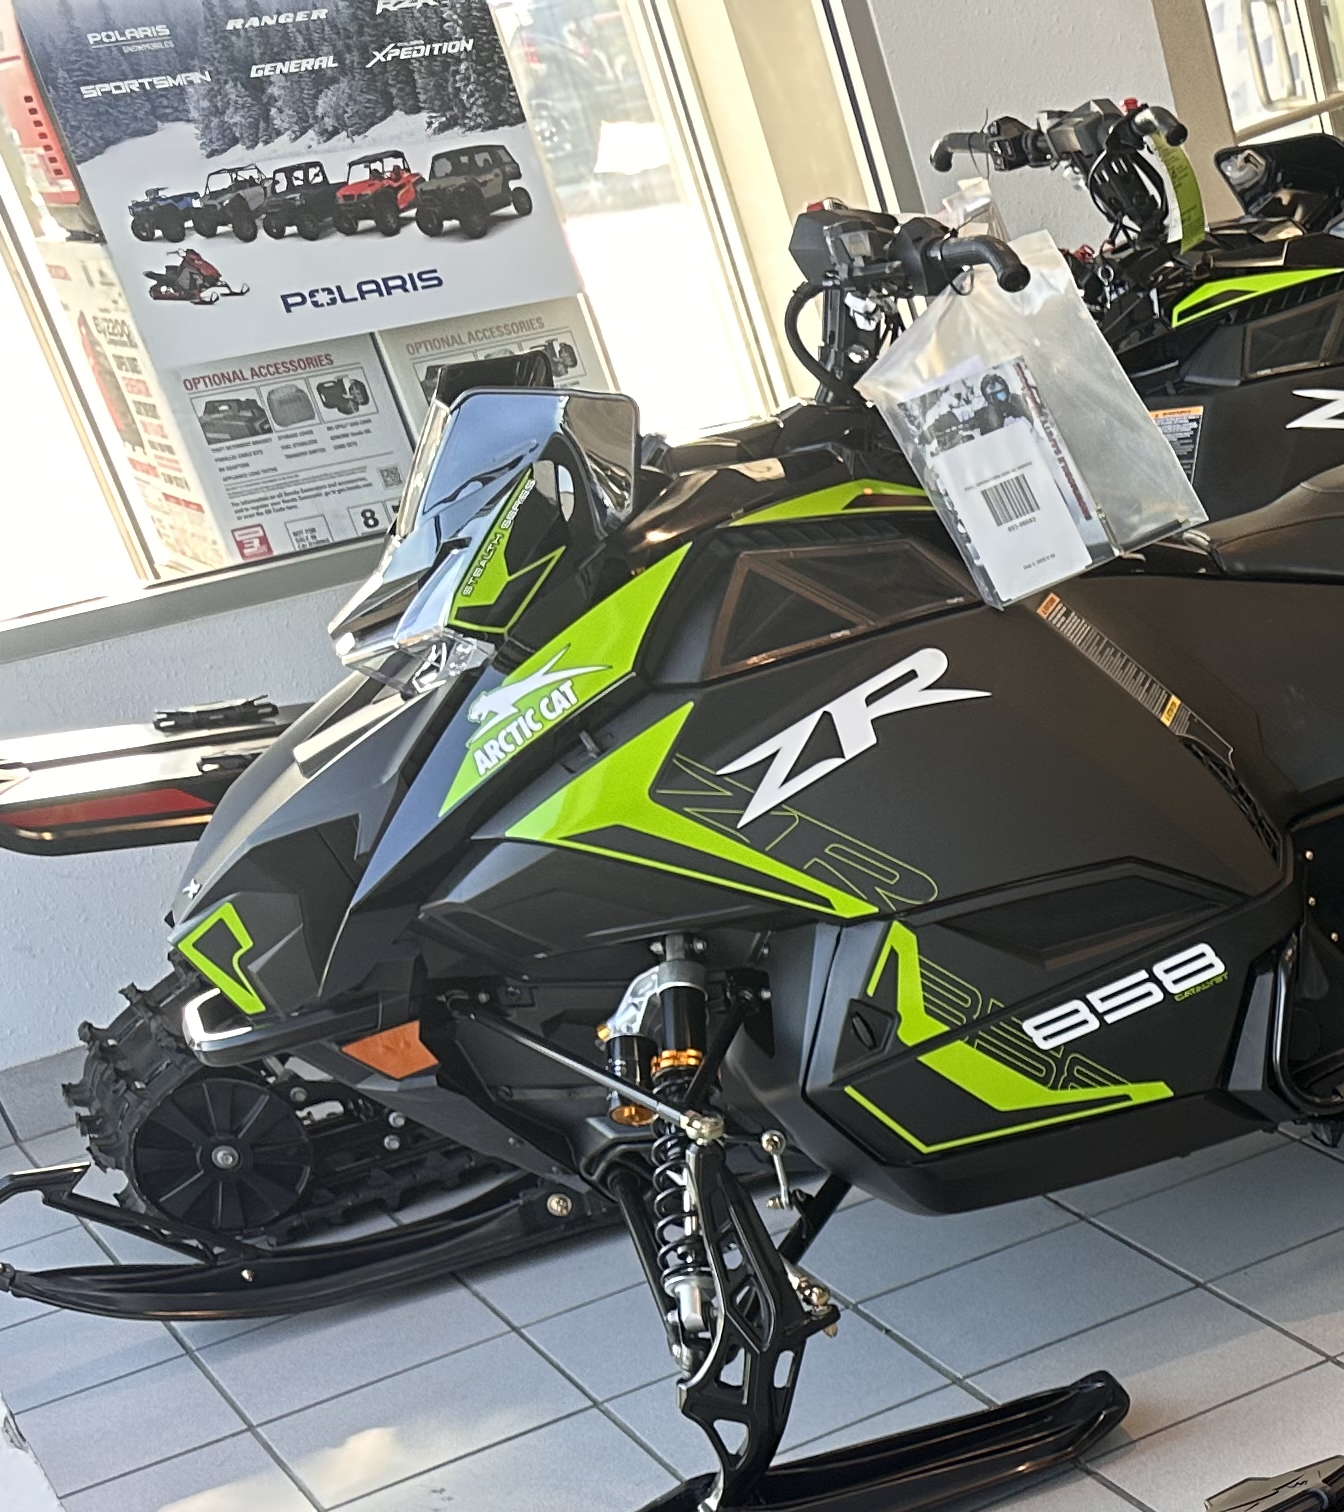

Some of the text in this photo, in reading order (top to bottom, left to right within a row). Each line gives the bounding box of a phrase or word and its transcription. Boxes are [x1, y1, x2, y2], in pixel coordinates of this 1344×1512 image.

[87, 25, 170, 44] POLARIS
[226, 8, 328, 30] RANGER
[250, 55, 339, 78] GENERAL
[366, 38, 473, 68] XPEDITION
[80, 71, 211, 99] SPORTSMAN
[280, 268, 444, 313] POLARIS
[405, 317, 545, 356] OPTIONAL ACCESSORIES
[183, 353, 335, 392] OPTIONAL ACCESSORIES
[360, 508, 380, 529] 8
[462, 477, 537, 597] STEALTH SERIES
[473, 680, 580, 777] ARCTIC CAT
[716, 647, 992, 829] ZR
[1022, 942, 1226, 1050] 858
[1174, 971, 1229, 1002] CATALYST
